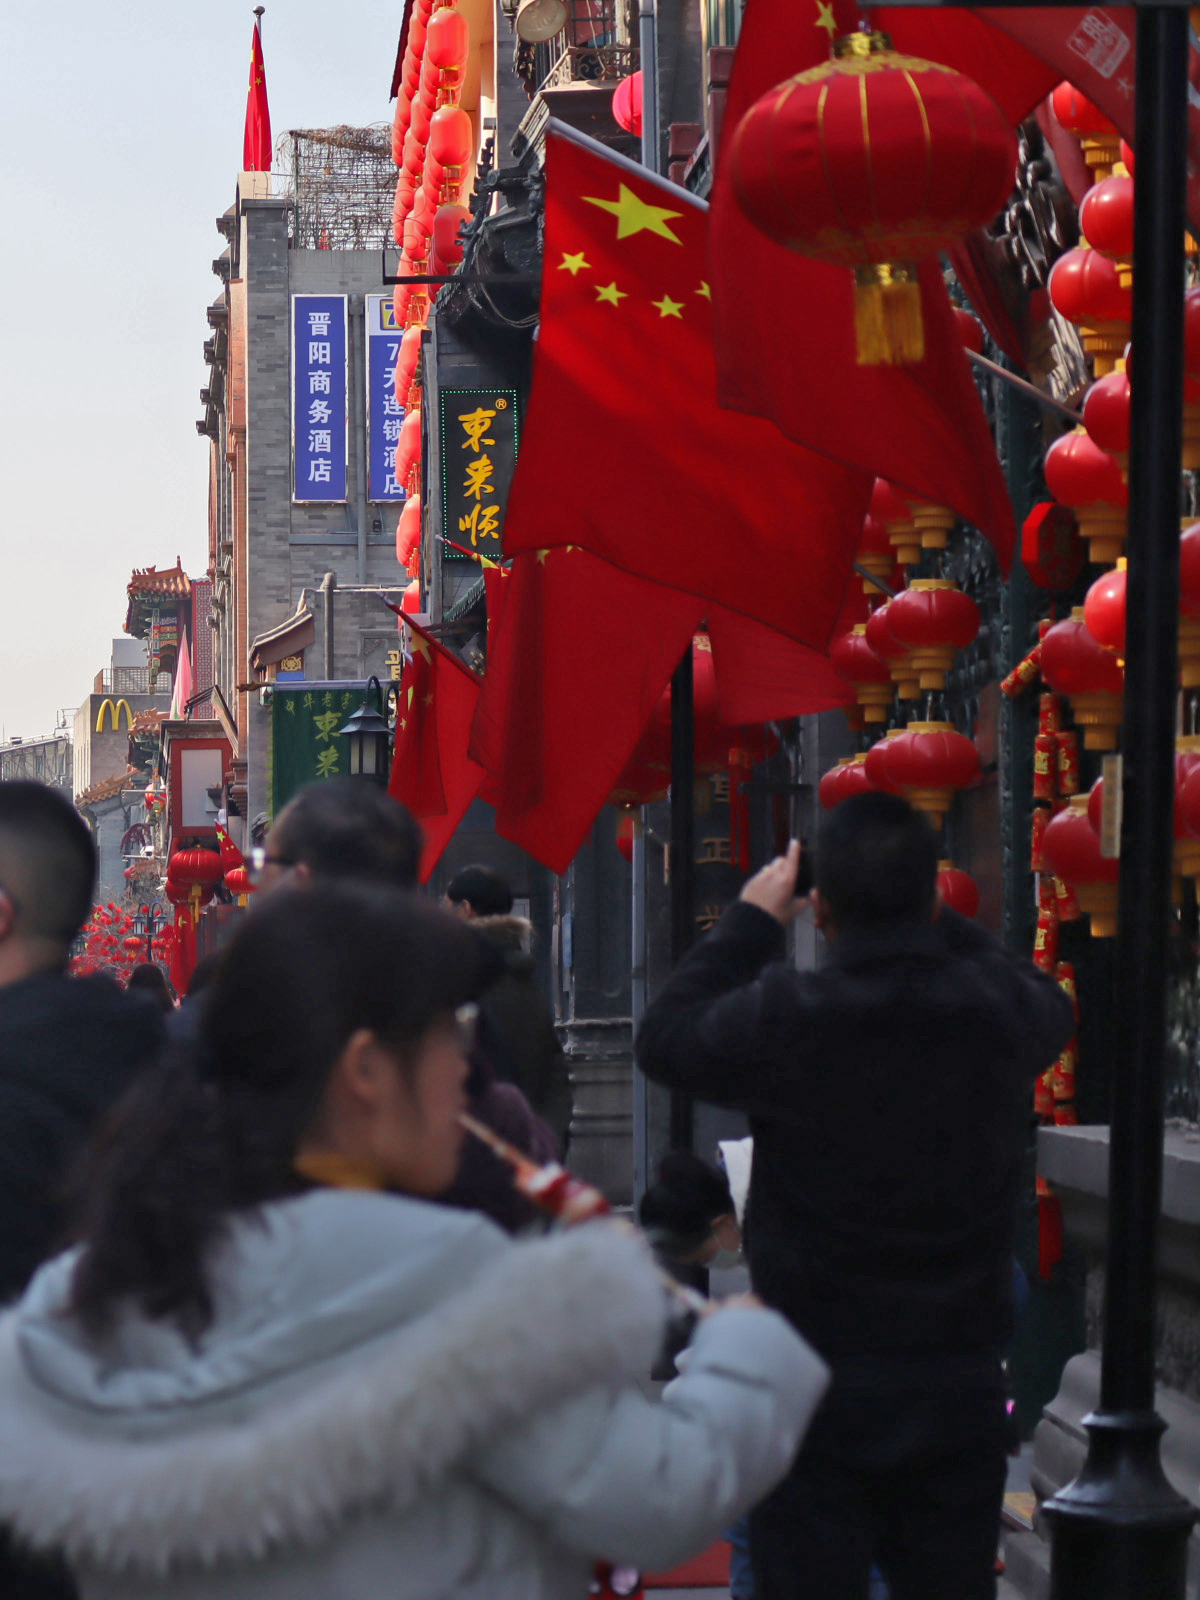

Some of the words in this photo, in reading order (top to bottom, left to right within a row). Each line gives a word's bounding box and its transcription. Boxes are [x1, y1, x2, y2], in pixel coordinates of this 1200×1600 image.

[308, 312, 332, 482] 晋阳商务酒店
